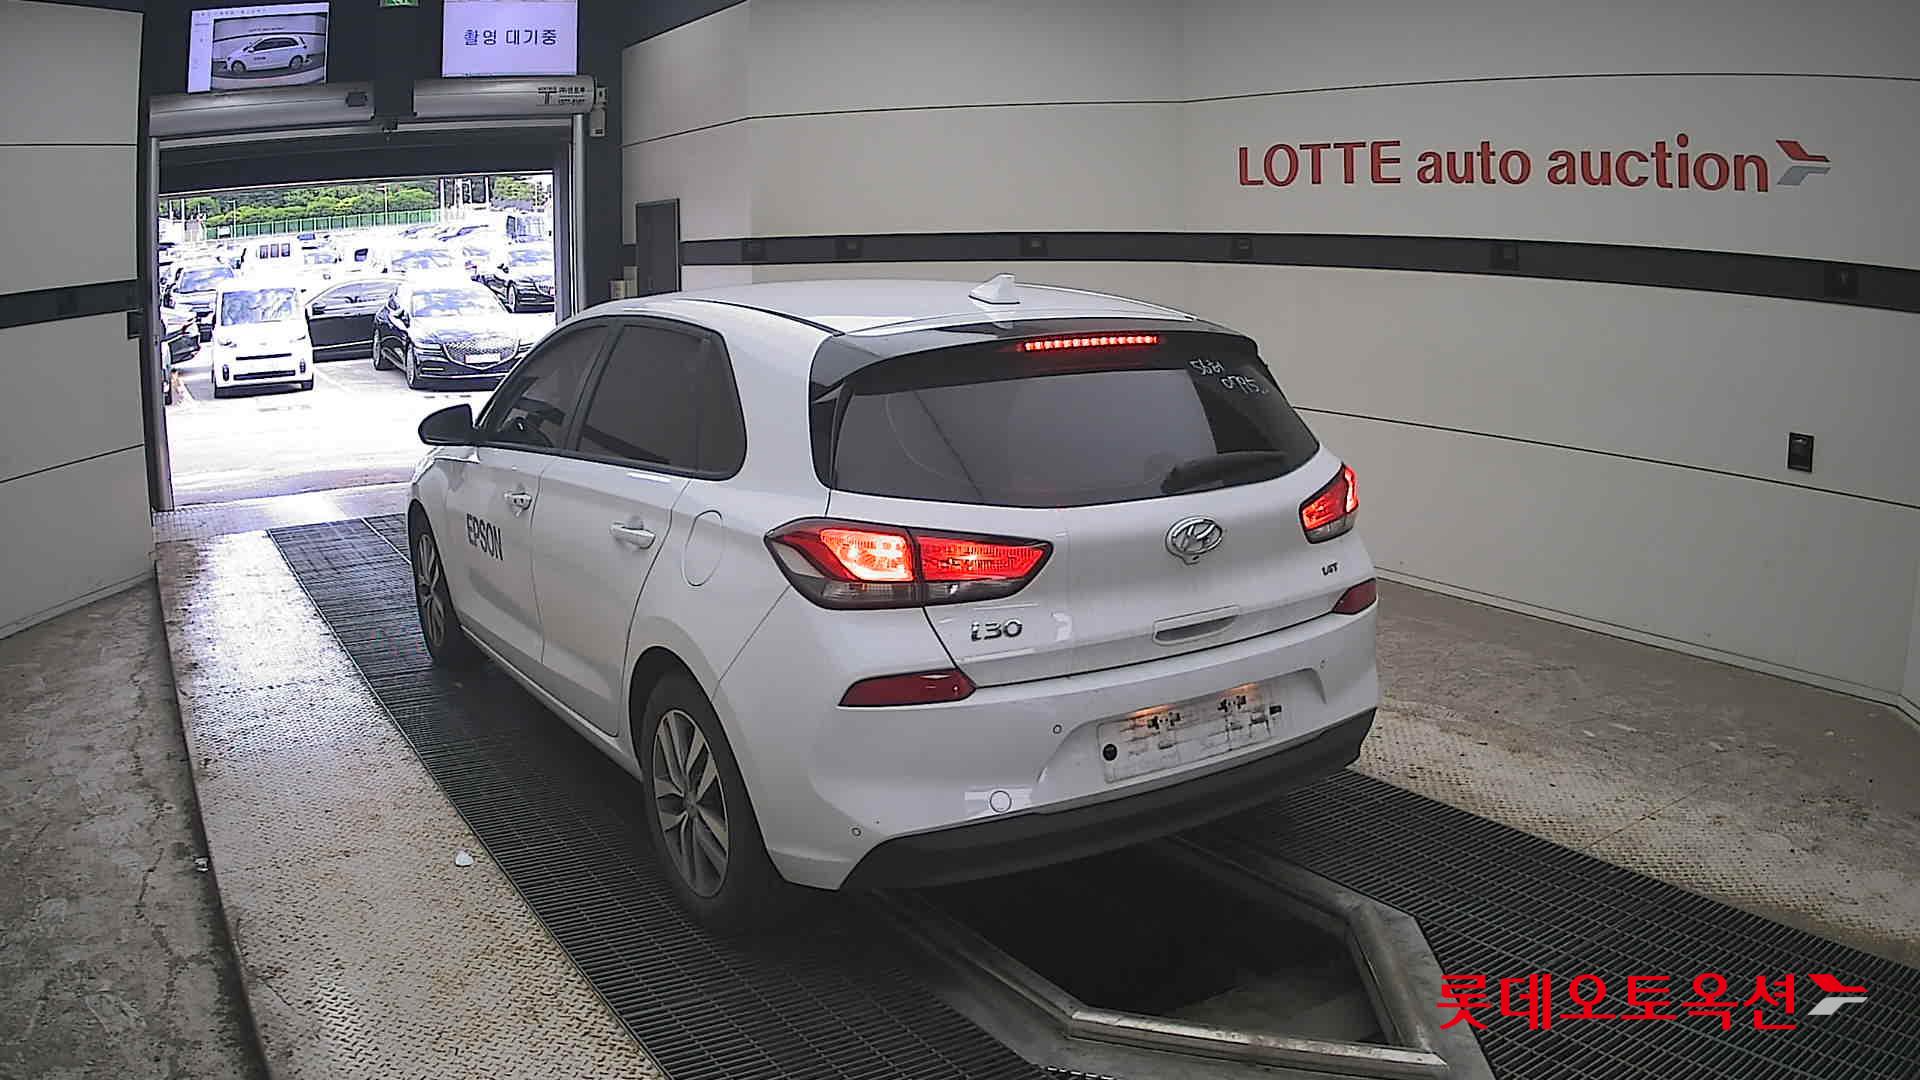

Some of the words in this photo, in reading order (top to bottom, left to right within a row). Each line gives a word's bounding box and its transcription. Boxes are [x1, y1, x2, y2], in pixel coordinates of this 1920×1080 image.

[505, 28, 558, 46] 대기중
[1239, 139, 1401, 186] LOTTE
[1416, 140, 1532, 186] auto
[1547, 132, 1769, 193] auction
[466, 512, 504, 561] EPSON
[971, 621, 1023, 641] i30
